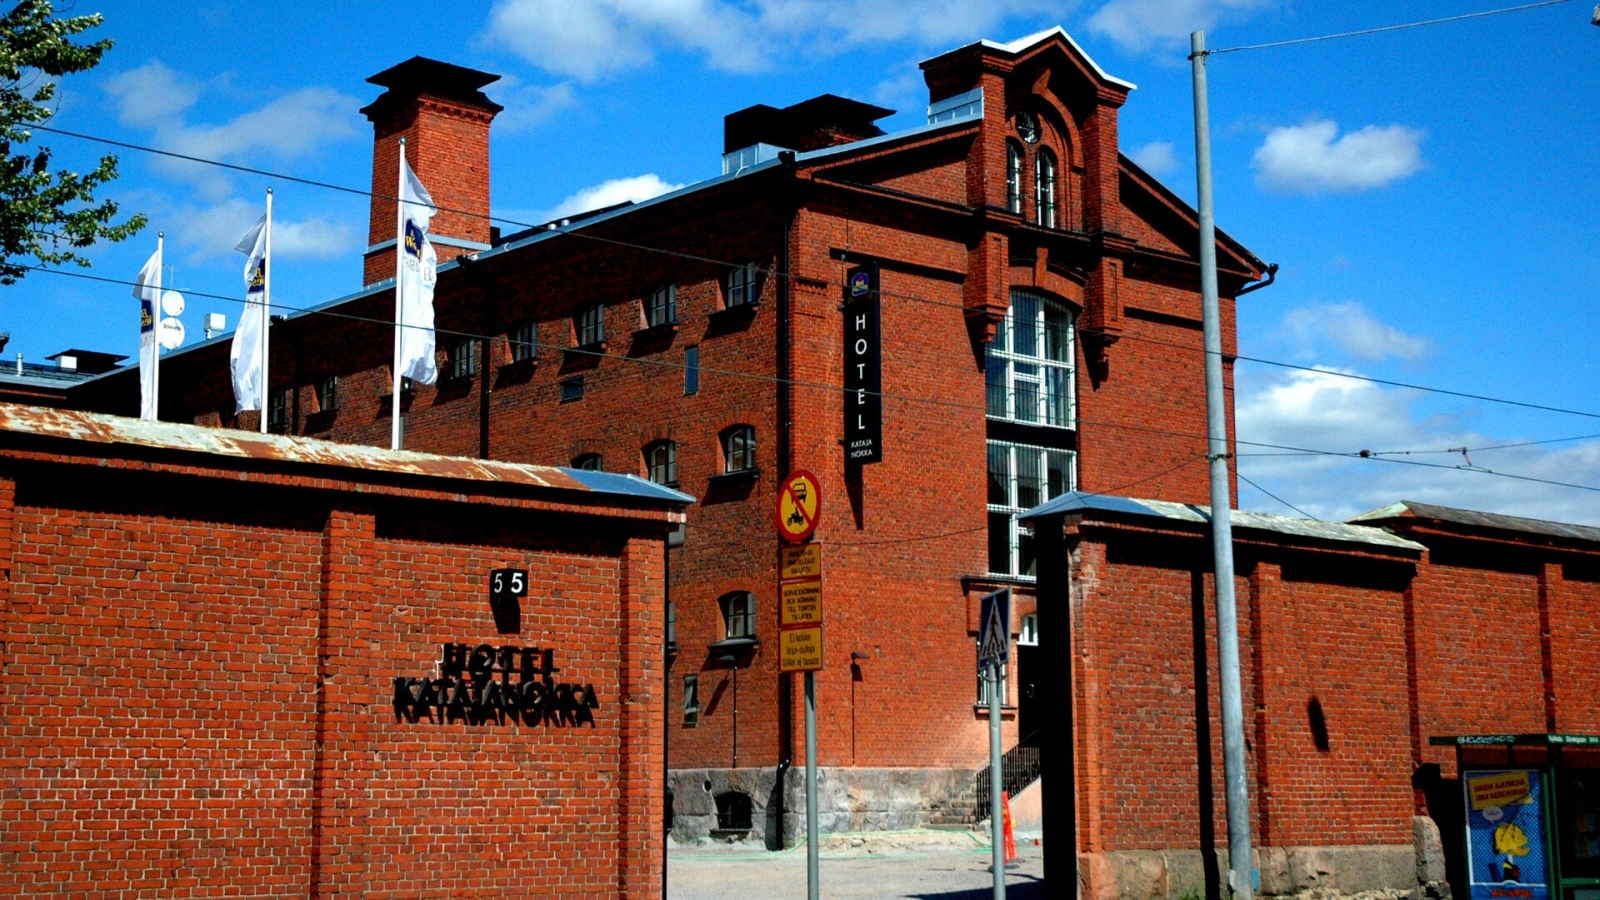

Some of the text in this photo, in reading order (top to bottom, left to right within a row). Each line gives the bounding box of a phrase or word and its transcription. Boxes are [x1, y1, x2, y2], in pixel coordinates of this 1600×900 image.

[855, 314, 867, 430] HOTEL
[851, 439, 872, 448] KATAJA
[851, 449, 872, 458] NOKKA
[494, 573, 503, 593] 5
[510, 573, 523, 593] 5
[442, 643, 560, 673] HOTEL
[394, 678, 599, 712] KATAJANOKKA
